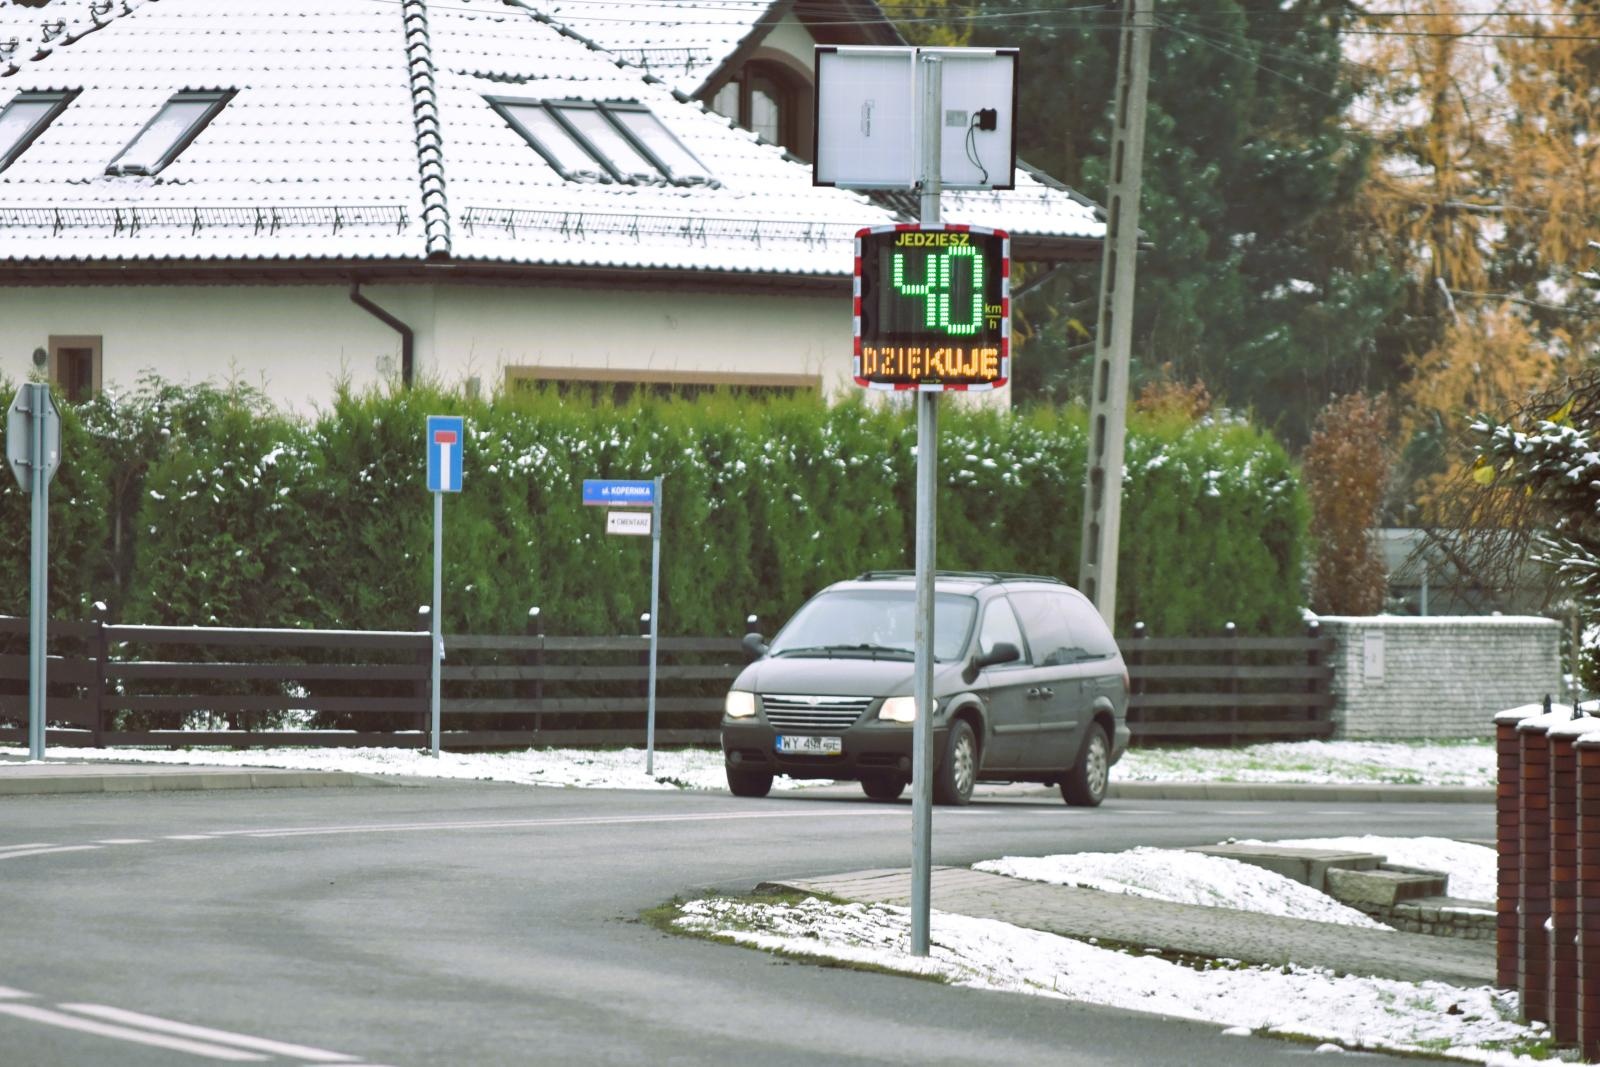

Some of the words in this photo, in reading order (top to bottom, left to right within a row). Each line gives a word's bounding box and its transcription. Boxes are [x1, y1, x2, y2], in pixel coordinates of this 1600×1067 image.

[895, 233, 970, 246] JEDZIESZ
[893, 246, 983, 335] 40
[985, 303, 1002, 313] km
[989, 319, 997, 329] h
[611, 486, 651, 496] KOPERNIKA
